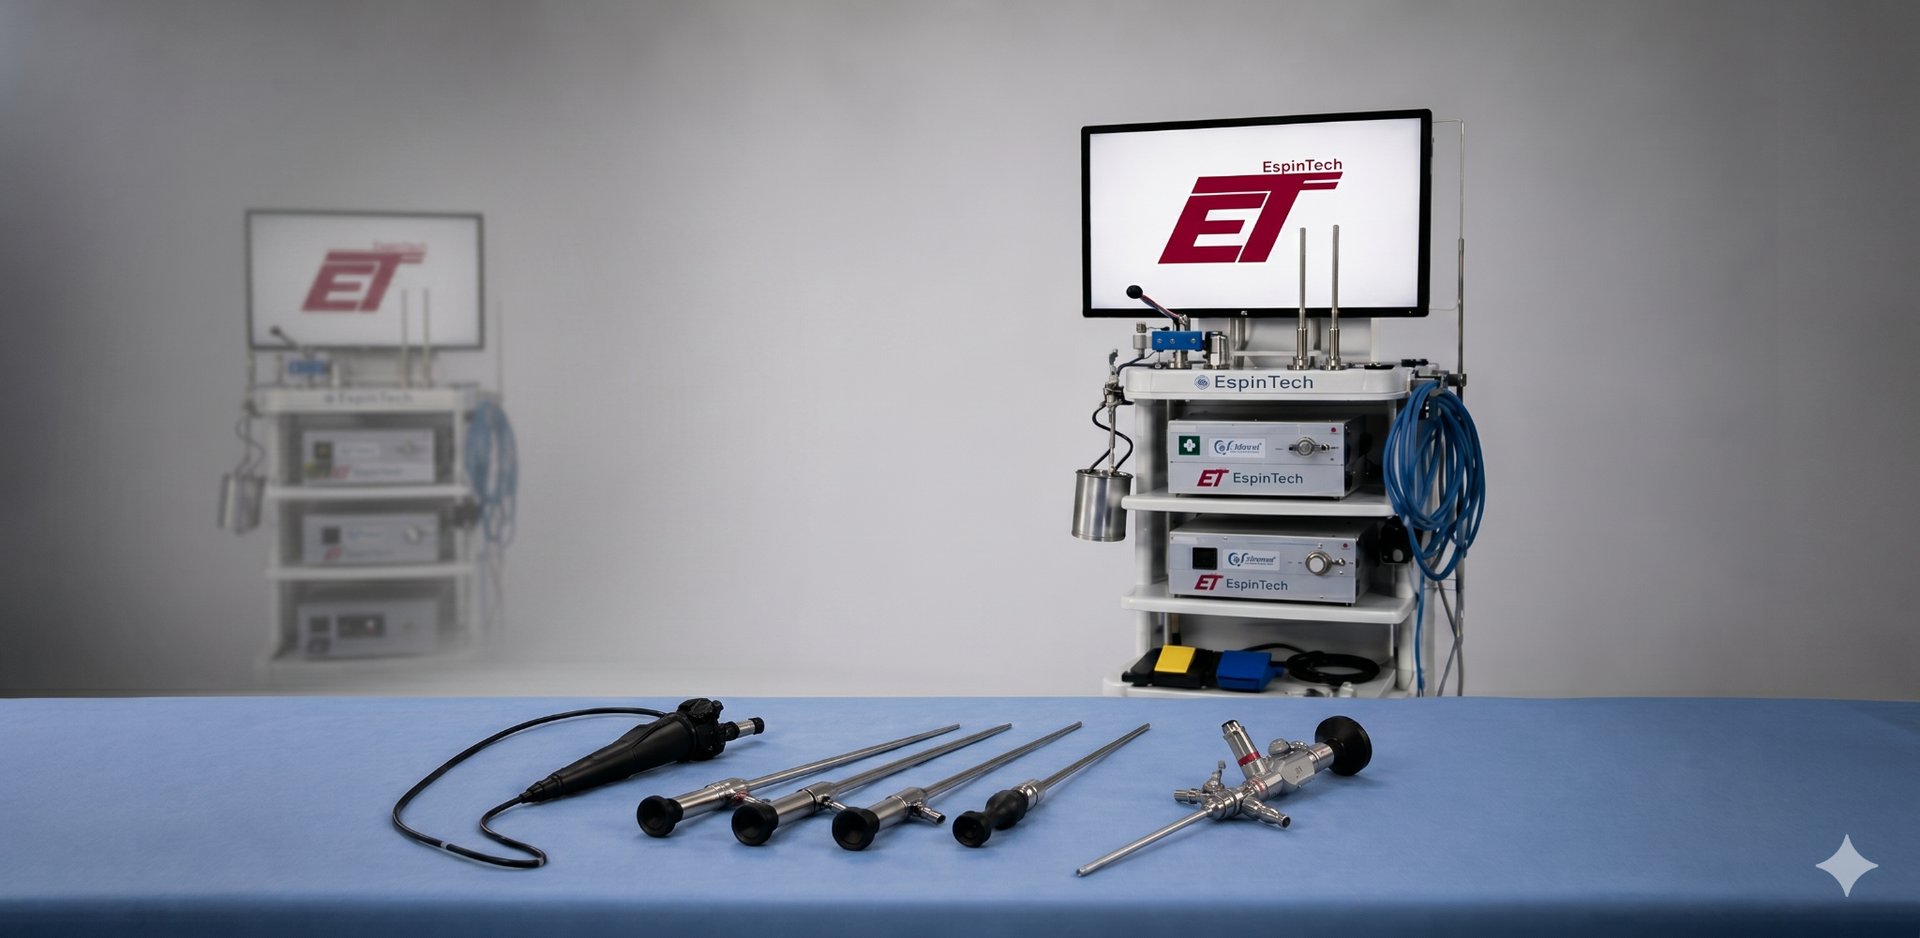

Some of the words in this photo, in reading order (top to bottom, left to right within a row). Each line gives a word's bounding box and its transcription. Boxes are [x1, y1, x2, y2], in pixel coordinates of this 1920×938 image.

[1262, 158, 1343, 174] EspinTech
[1157, 171, 1343, 264] ET
[301, 249, 427, 312] ET
[1214, 375, 1314, 392] EspinTech
[1197, 469, 1229, 487] ET
[1233, 472, 1303, 487] EspinTech
[1194, 574, 1224, 591] ET
[1226, 577, 1288, 592] EspinTech
